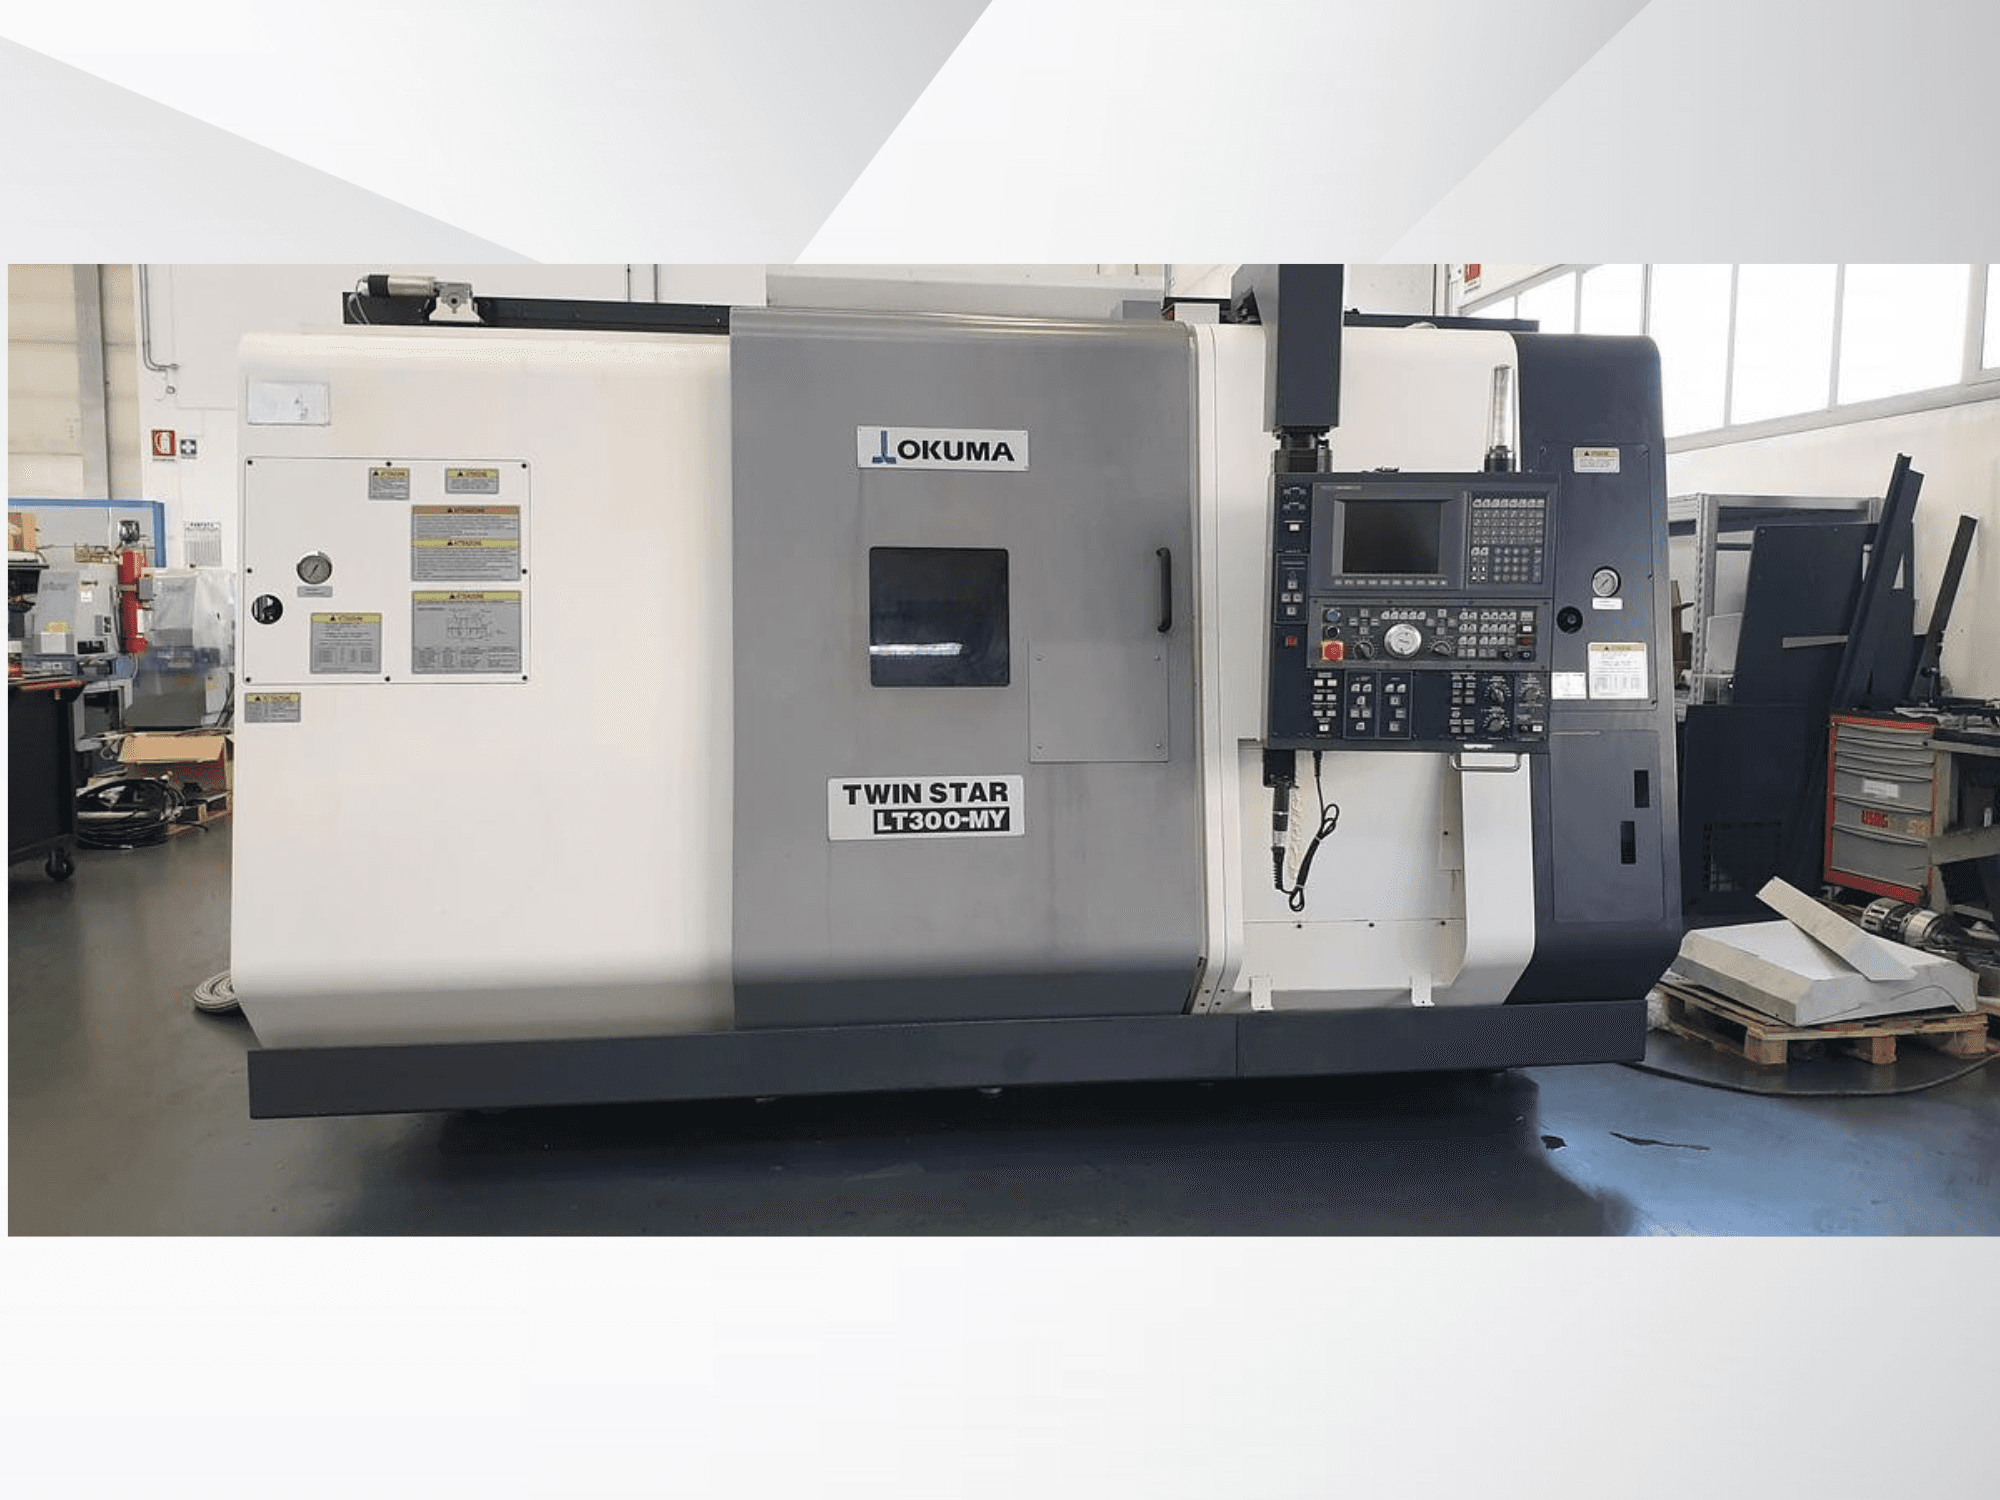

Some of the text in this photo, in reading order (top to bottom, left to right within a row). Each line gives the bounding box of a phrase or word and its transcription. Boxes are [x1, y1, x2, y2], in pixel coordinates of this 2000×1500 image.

[897, 440, 1015, 462] OKUMA
[842, 782, 1009, 805] TWIN STAR
[876, 809, 1007, 831] LT300-MY
